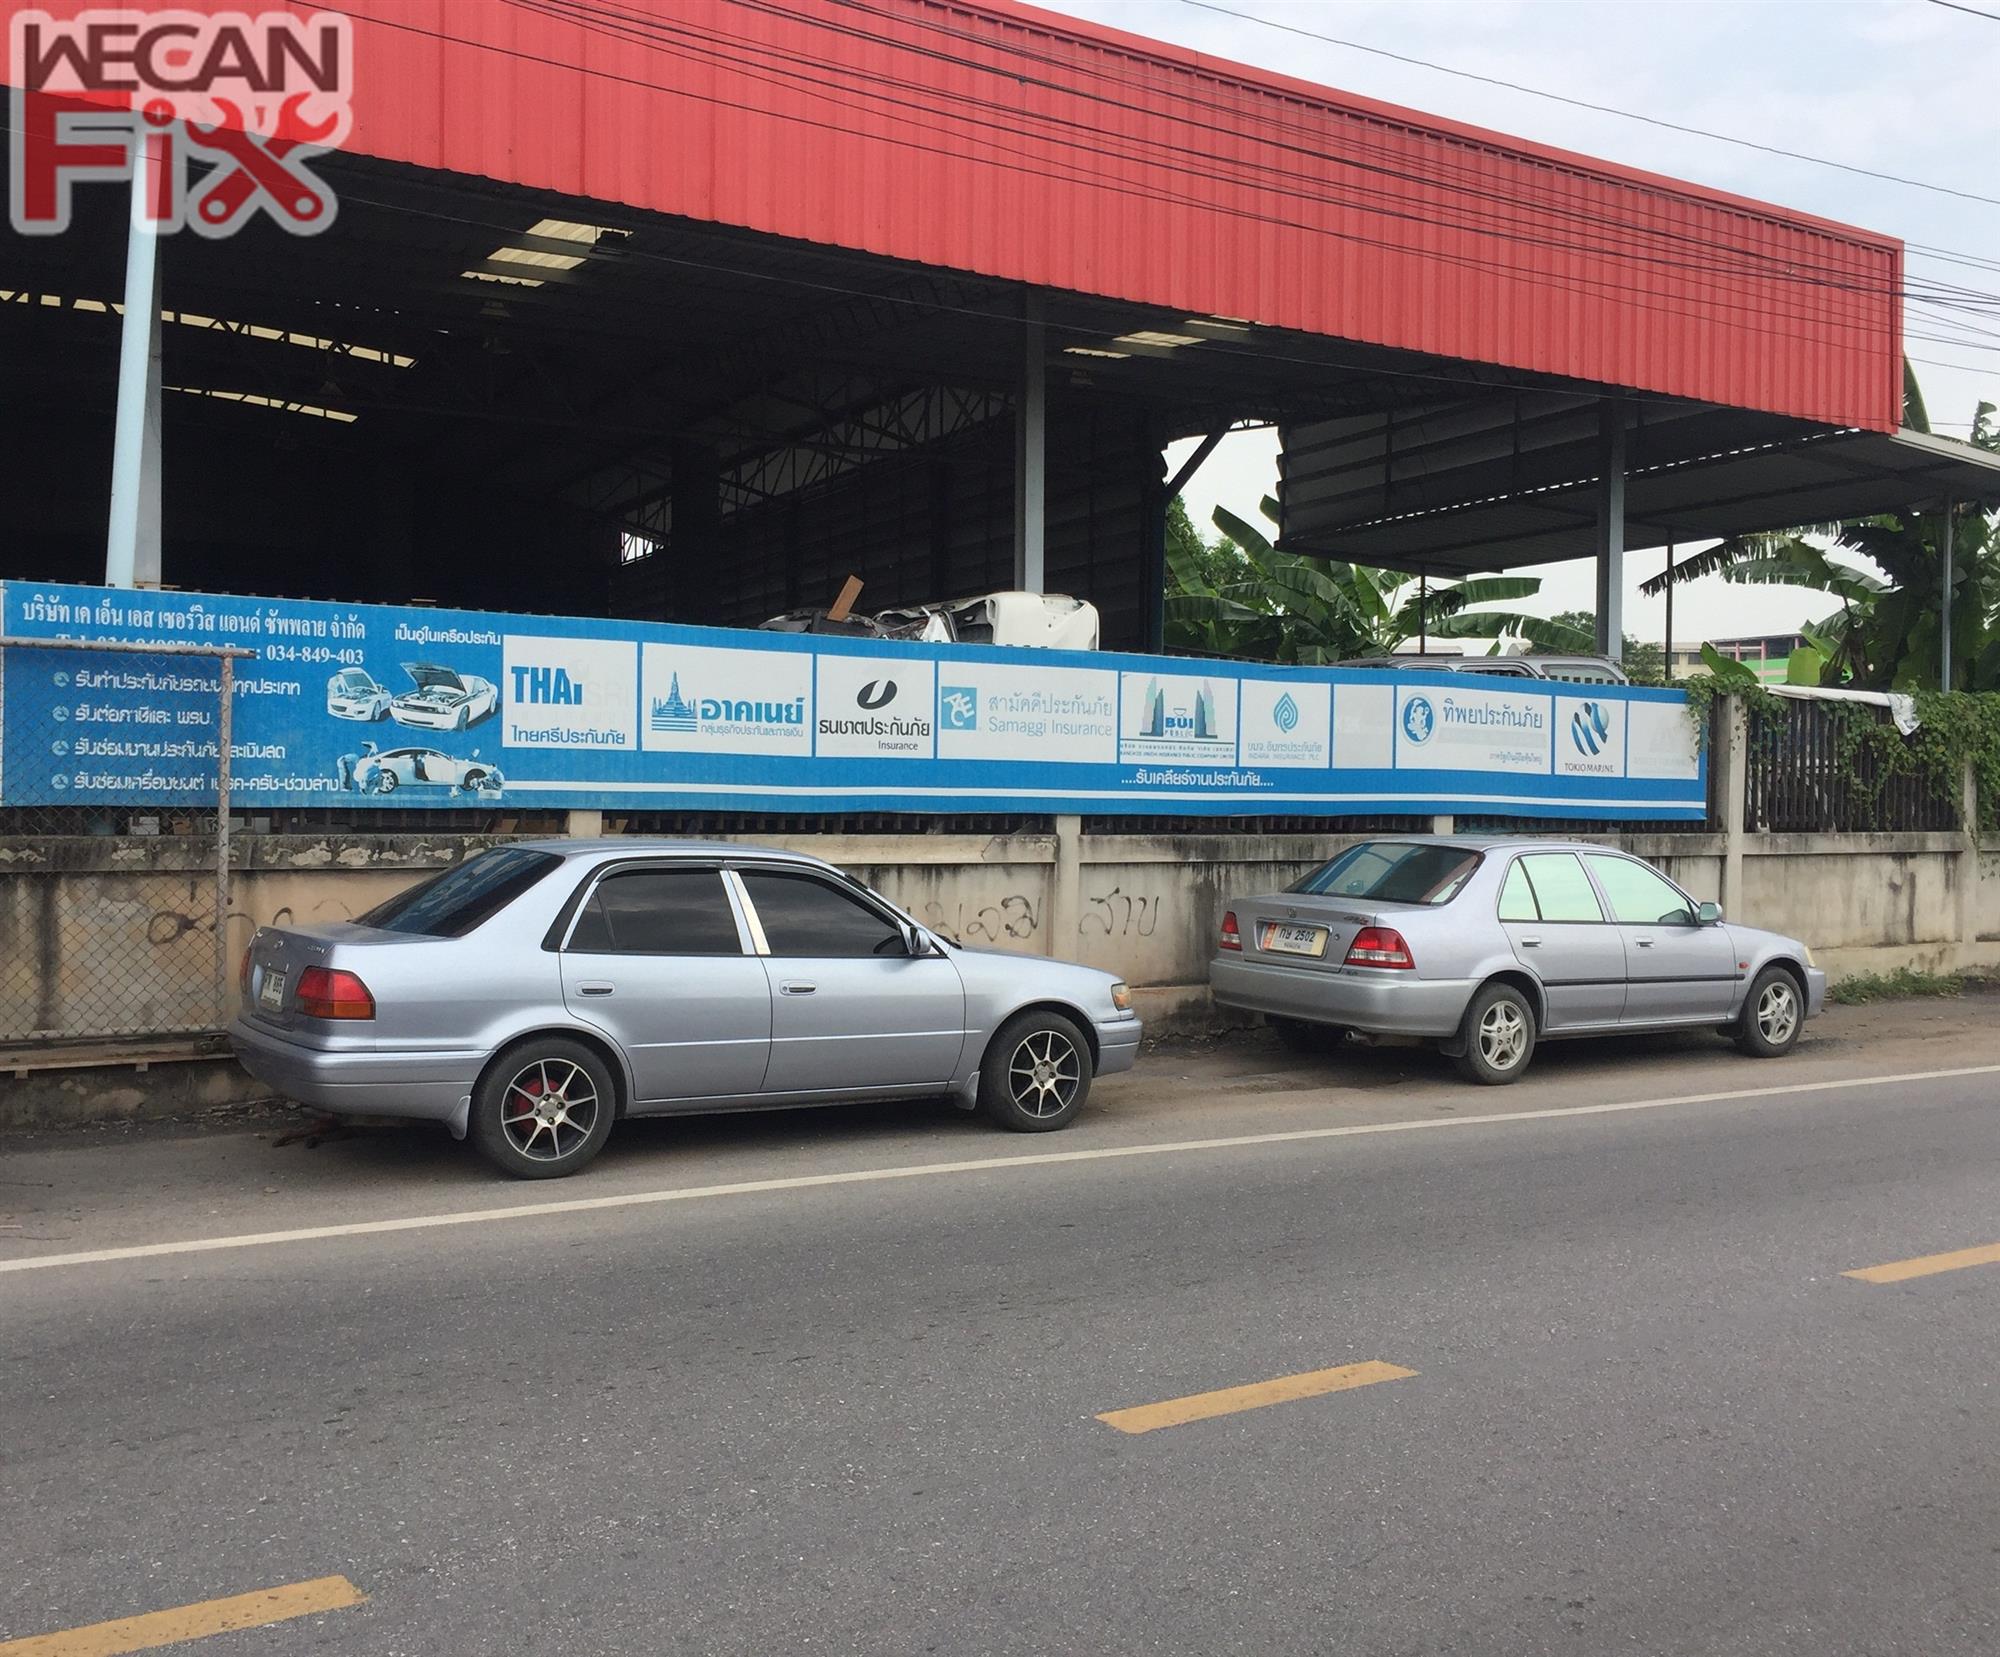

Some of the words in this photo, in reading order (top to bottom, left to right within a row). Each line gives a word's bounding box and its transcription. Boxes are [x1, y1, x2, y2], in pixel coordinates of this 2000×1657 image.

[22, 594, 70, 623] บริษัท
[75, 606, 91, 625] เค
[95, 598, 123, 626] เอ็น
[127, 609, 154, 629] เอส
[158, 604, 216, 631] เซอร์วิส
[219, 608, 260, 634] แอนด์
[264, 609, 327, 637] ซัพพลาย
[330, 614, 366, 640] จำกัด
[266, 645, 364, 665] 034-849-403
[701, 697, 805, 724] อาคเนย์
[988, 691, 1113, 717] สามัคคีประกันภัย
[1443, 698, 1543, 729] ทิพยประกันภัย
[819, 717, 930, 736] ธนชาตประกันภัย
[989, 716, 1047, 737] Samaggi
[1051, 719, 1113, 737] Insurance
[1165, 717, 1194, 729] BUI
[511, 725, 626, 745] ไทยศรีประกันภัย
[878, 740, 918, 751] Insurance
[1292, 930, 1315, 943] 2502
